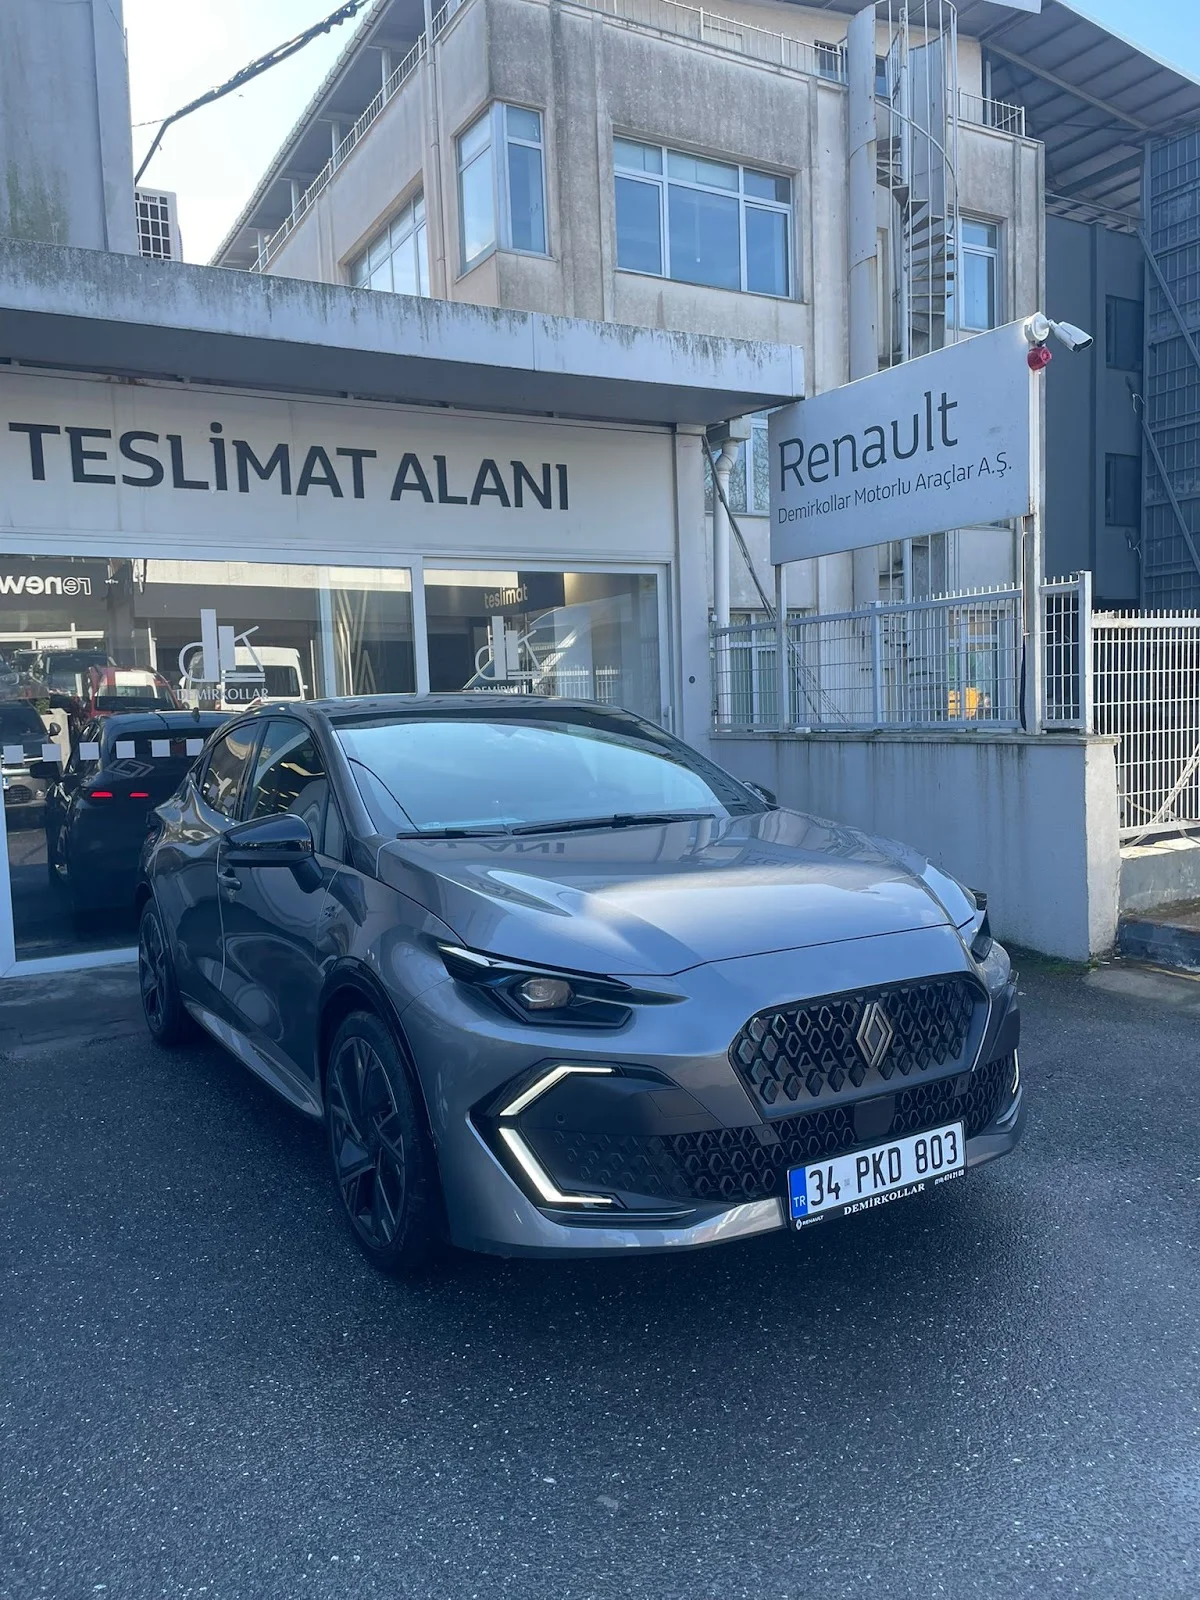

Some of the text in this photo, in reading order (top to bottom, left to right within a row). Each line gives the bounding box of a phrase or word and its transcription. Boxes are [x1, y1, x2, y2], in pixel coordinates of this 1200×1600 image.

[8, 421, 569, 511] TESLİMAT ALANI
[778, 391, 958, 492] Renault
[778, 452, 1012, 525] Demirkollar Motorlu Araçlar A.Ş.
[793, 1195, 807, 1208] TR
[808, 1130, 958, 1206] 34 PKD 803
[843, 1182, 926, 1216] DEMİRKOLLAR
